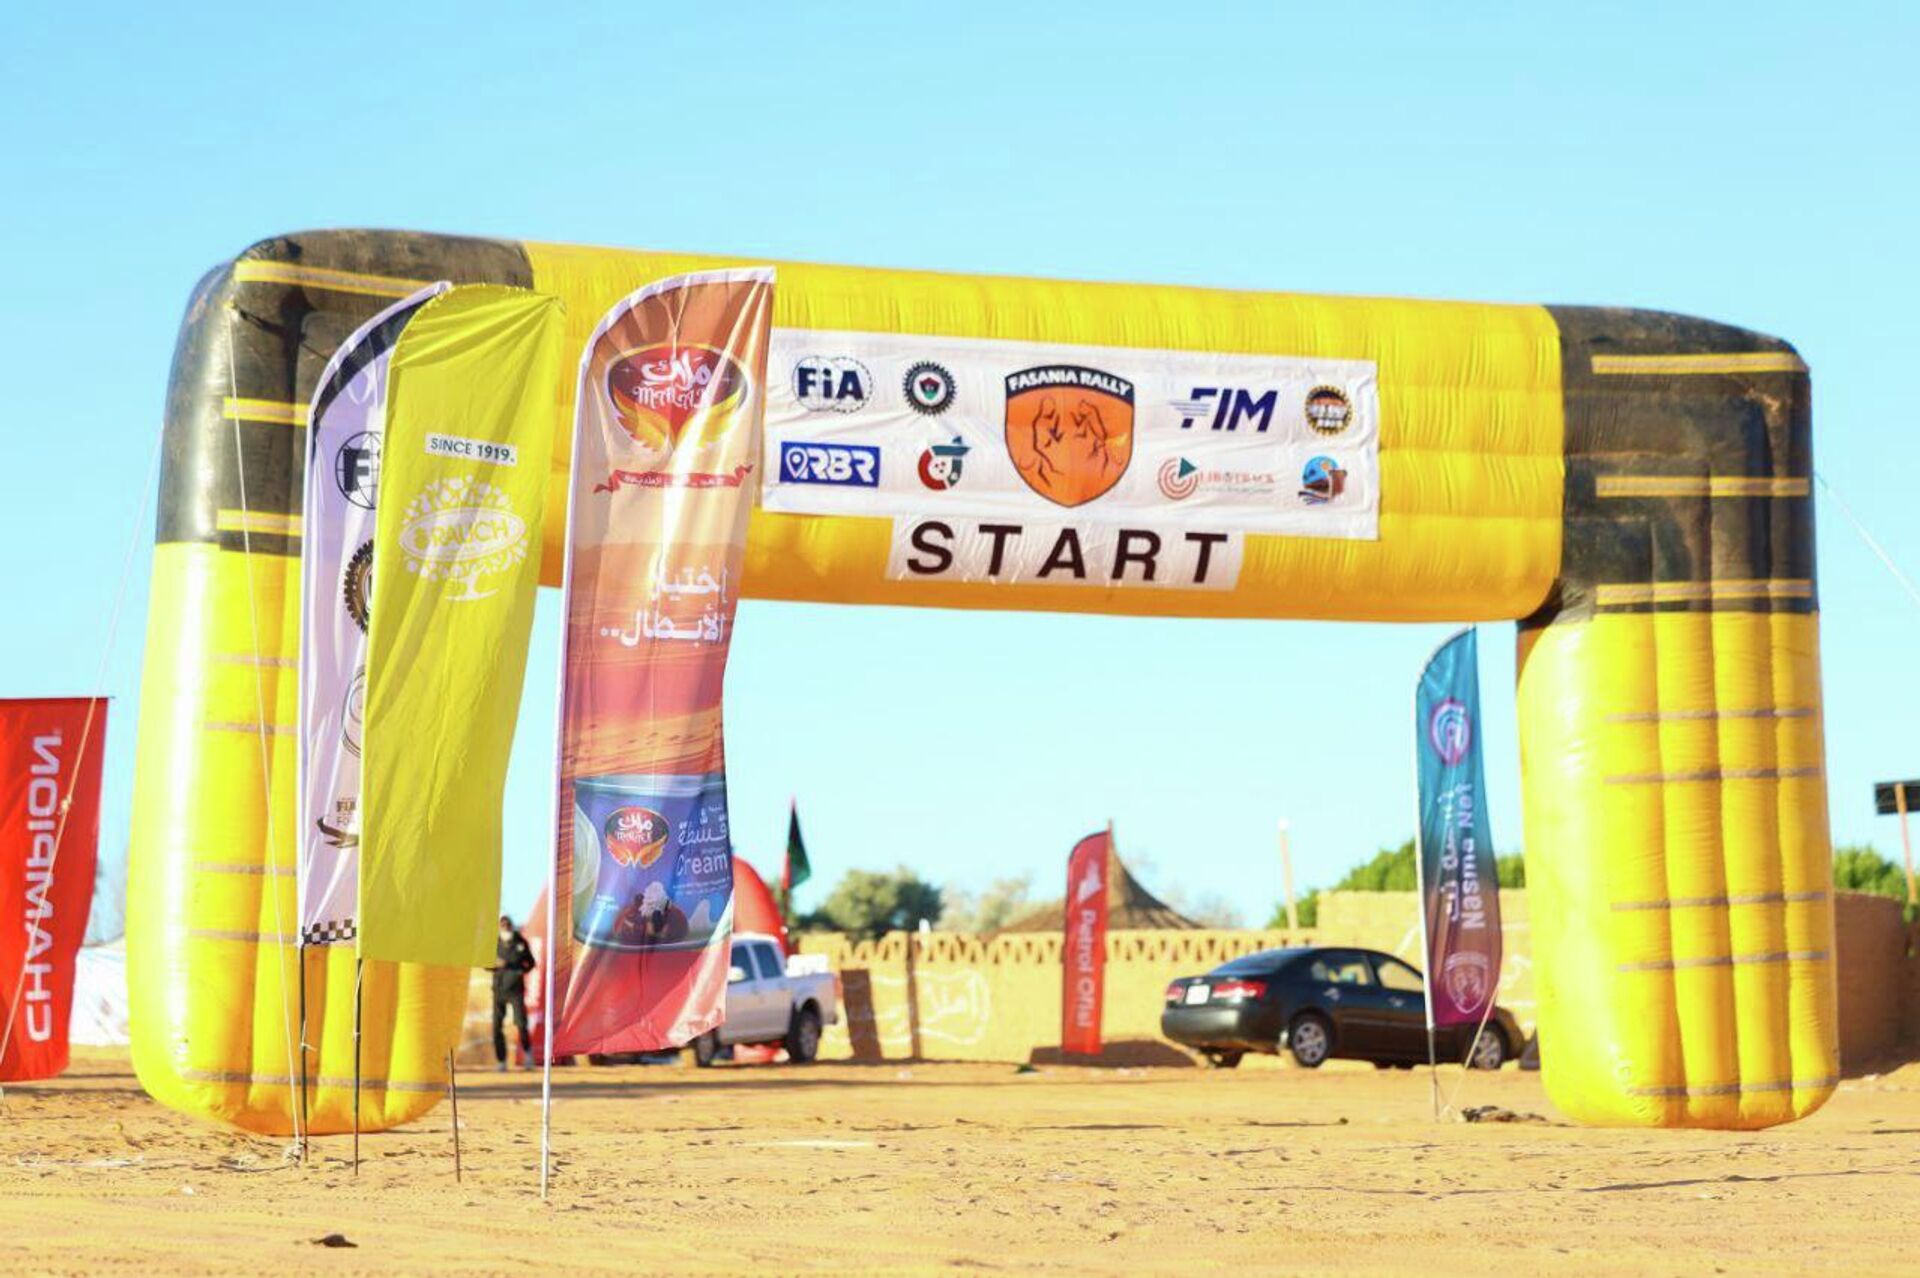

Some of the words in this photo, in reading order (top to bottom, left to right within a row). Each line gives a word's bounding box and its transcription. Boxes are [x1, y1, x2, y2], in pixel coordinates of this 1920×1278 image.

[1008, 369, 1078, 391] FASANIA
[1080, 371, 1131, 395] RALLY
[1179, 387, 1278, 432] FIM
[430, 437, 472, 455] SINCE
[906, 521, 1228, 583] START
[1455, 782, 1473, 829] Net
[676, 852, 728, 877] Cream
[1461, 838, 1486, 930] Nasma
[1079, 909, 1097, 972] Petrol
